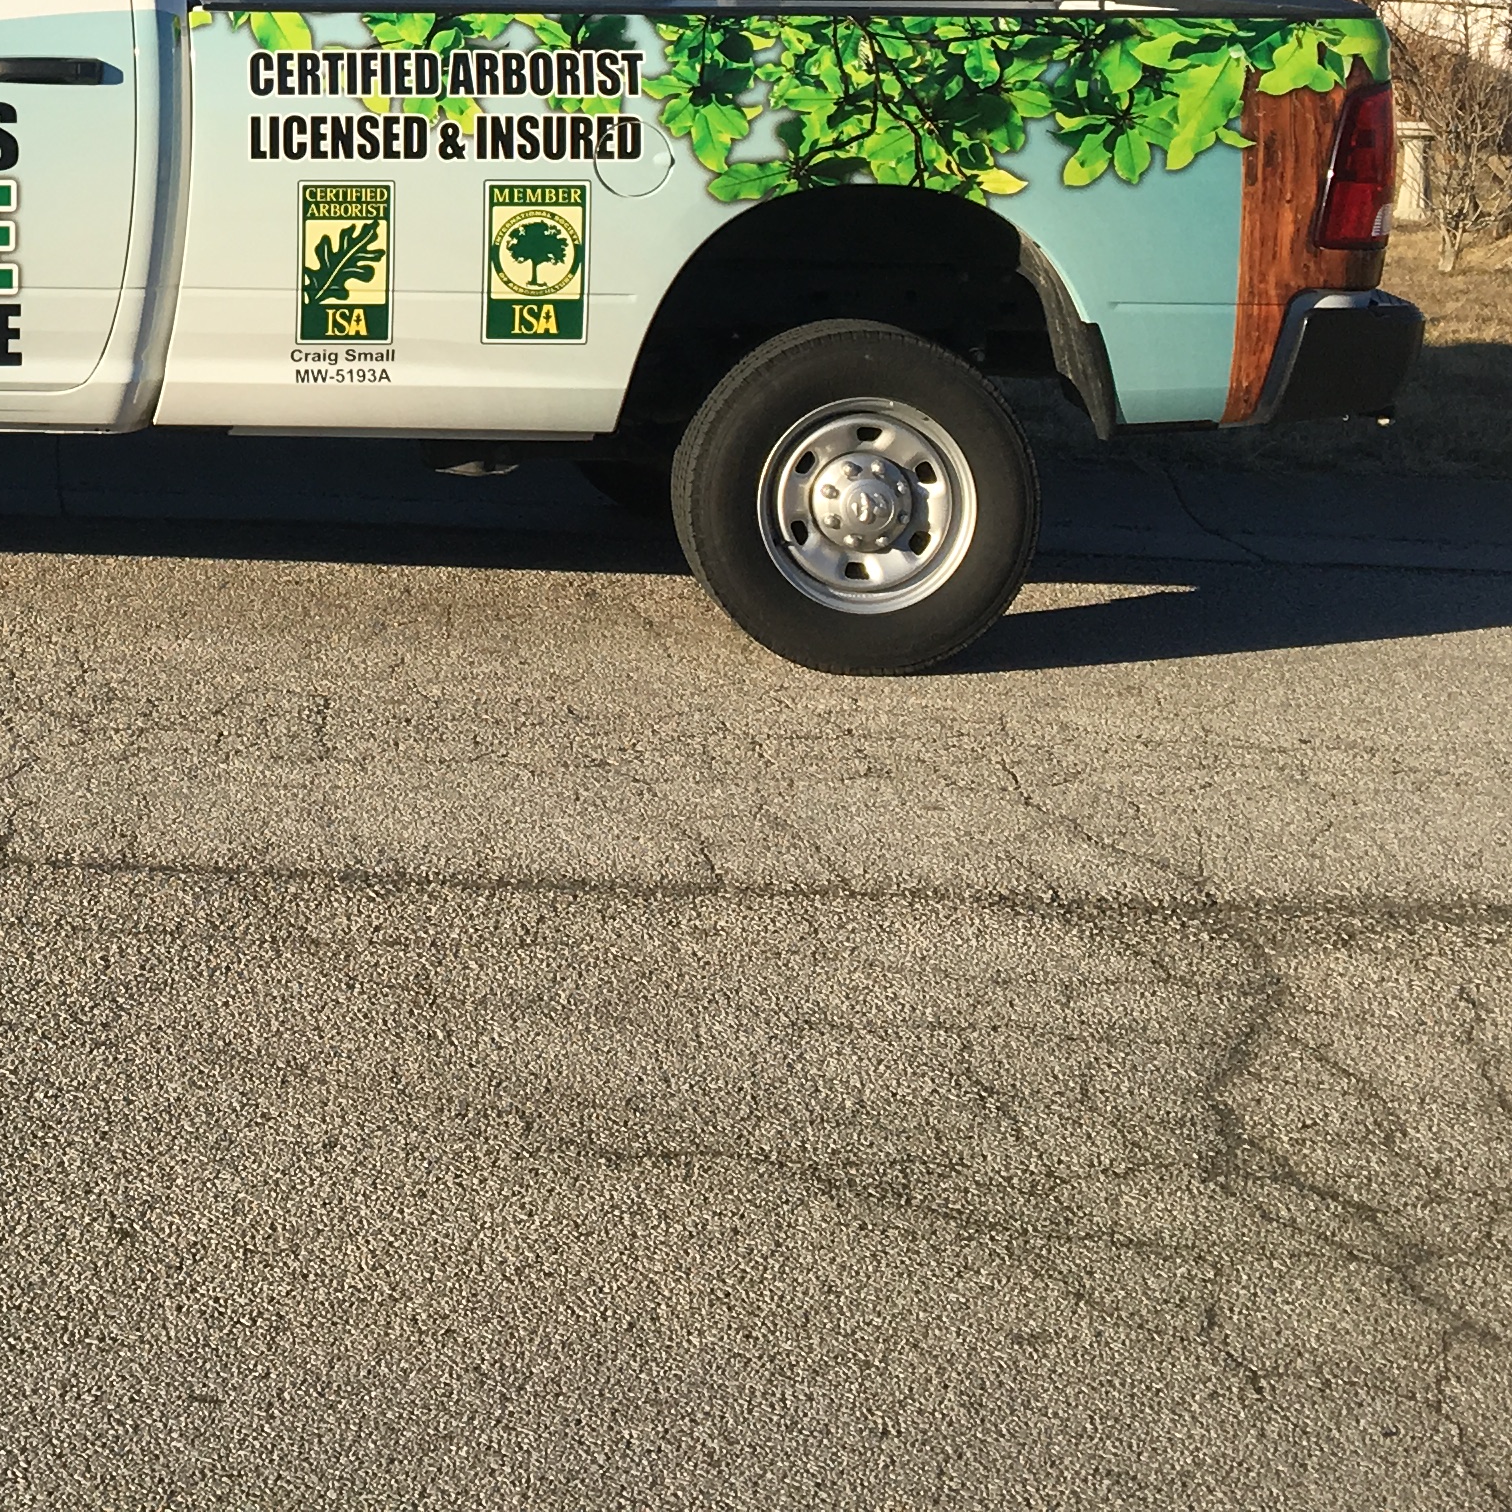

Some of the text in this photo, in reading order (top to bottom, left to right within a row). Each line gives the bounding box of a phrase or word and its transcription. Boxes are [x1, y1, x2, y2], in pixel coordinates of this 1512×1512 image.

[249, 51, 644, 97] CERTIFIED ARBORIST
[249, 114, 642, 161] LICENSED & INSURED
[305, 187, 388, 202] CERTIFIED
[493, 187, 582, 204] MEMBER
[306, 203, 388, 218] ARBORIST
[324, 308, 368, 336] ISA
[510, 303, 559, 334] ISA
[290, 348, 396, 366] Craig Small
[295, 368, 392, 384] MW-5193A
